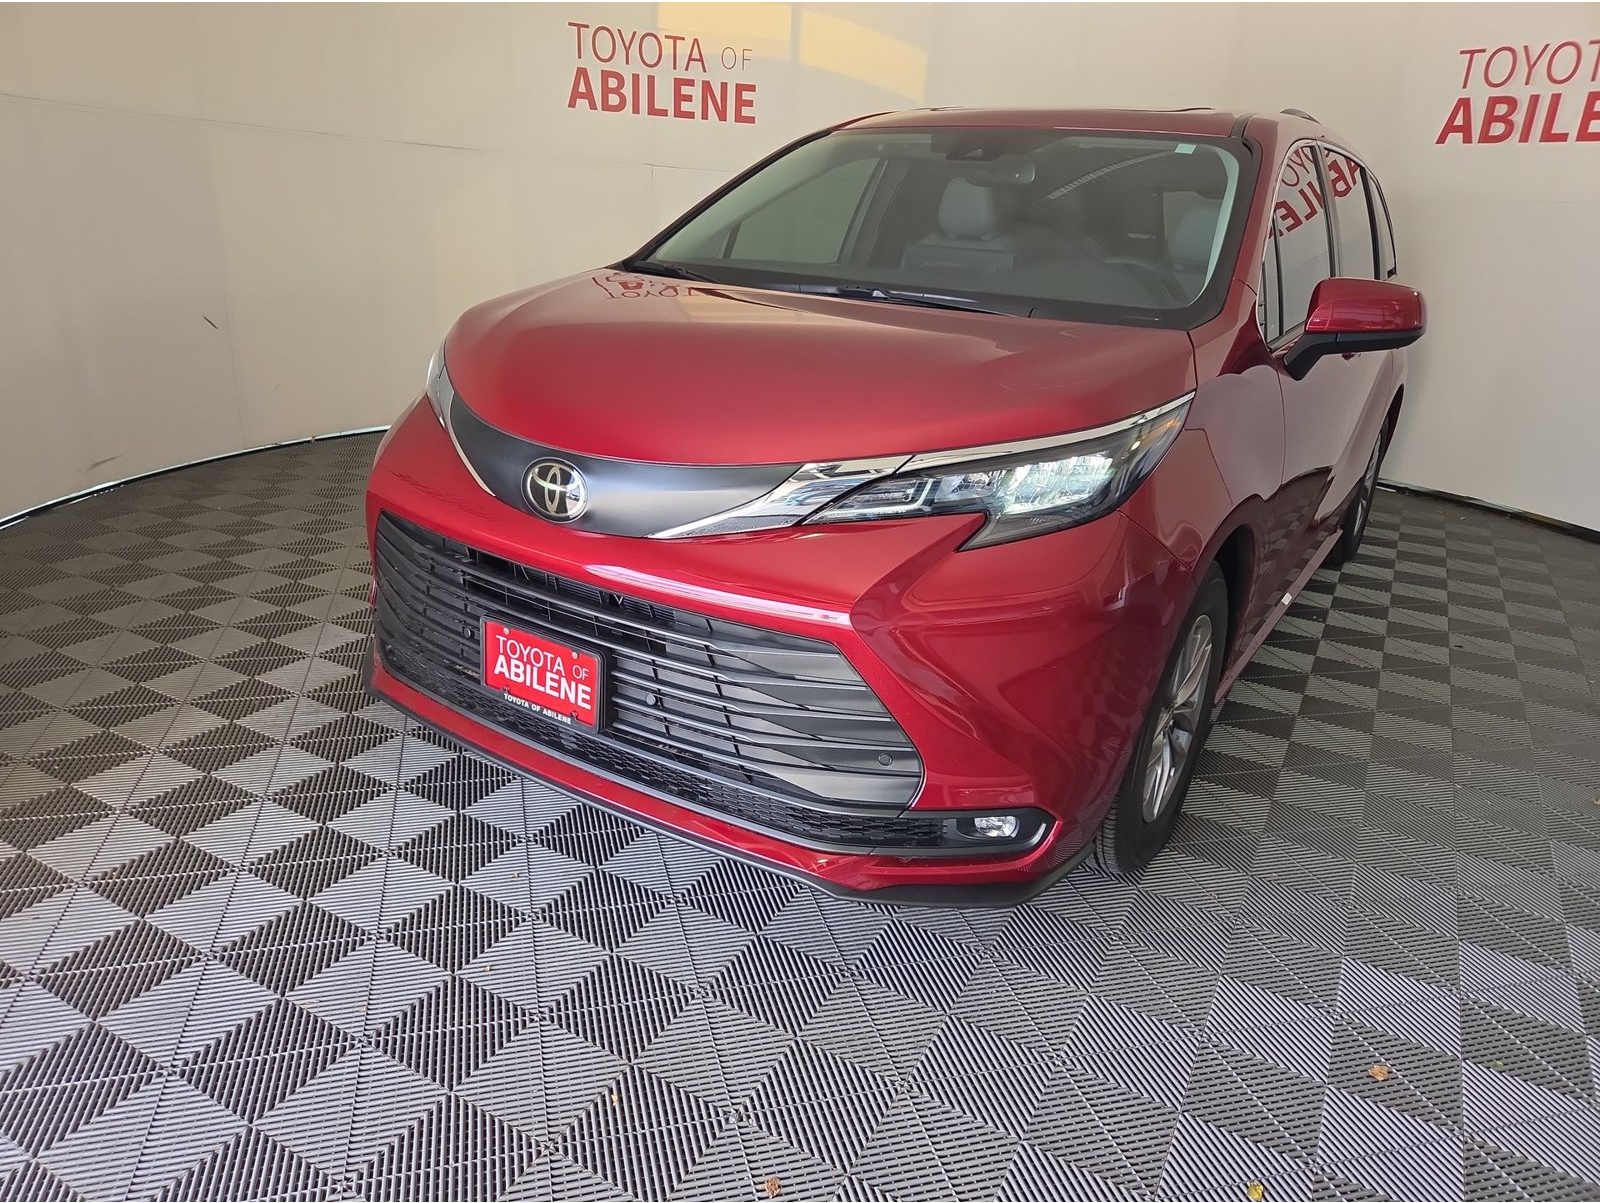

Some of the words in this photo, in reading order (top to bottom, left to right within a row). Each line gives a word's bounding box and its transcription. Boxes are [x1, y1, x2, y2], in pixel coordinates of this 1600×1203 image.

[568, 22, 707, 73] TOYOTA
[721, 47, 753, 71] OF
[567, 66, 756, 124] ABILENE
[493, 654, 591, 710] ABILENE
[495, 635, 565, 676] TOYOTA
[572, 665, 589, 680] OF
[504, 693, 529, 708] TOYOTA
[531, 704, 541, 712] OF
[543, 708, 571, 724] ABILENE
